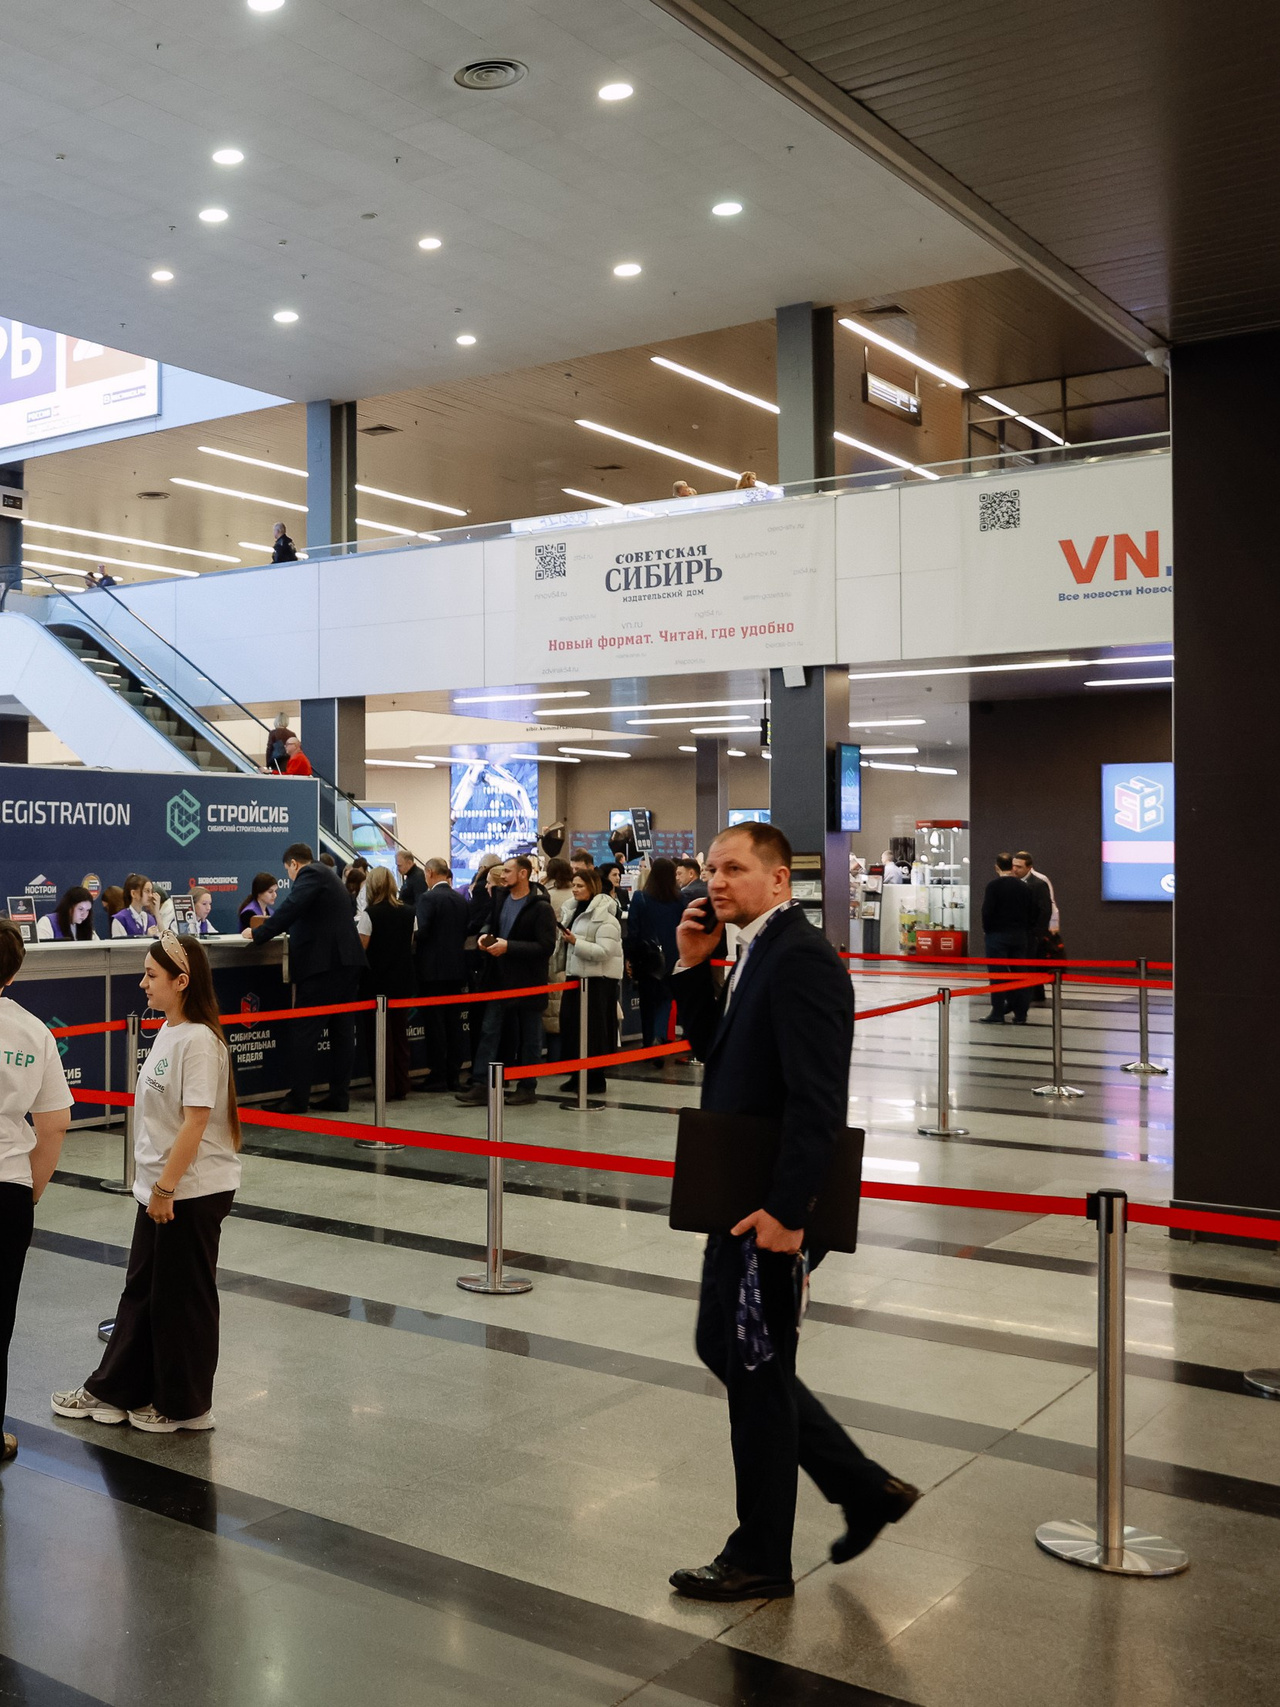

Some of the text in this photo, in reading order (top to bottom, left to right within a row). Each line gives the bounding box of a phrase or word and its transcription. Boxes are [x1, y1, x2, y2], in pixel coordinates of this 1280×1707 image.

[605, 557, 723, 593] СИБИРЬ
[622, 588, 704, 603] издательский дом
[1059, 592, 1079, 601] Все
[1083, 589, 1132, 599] новости
[548, 620, 795, 651] Новый формат. Читай, где удобно
[207, 801, 289, 824] СТРОЙСИБ
[207, 825, 234, 833] СИБИРСКИЙ
[236, 825, 271, 833] СТРОИТЕЛЬНЫЙ
[230, 1030, 270, 1043] СИБИРСКАЯ
[228, 1040, 276, 1053] ТРОИТЕЛЬНАЯ
[237, 1052, 263, 1063] НЕДЕЛЯ
